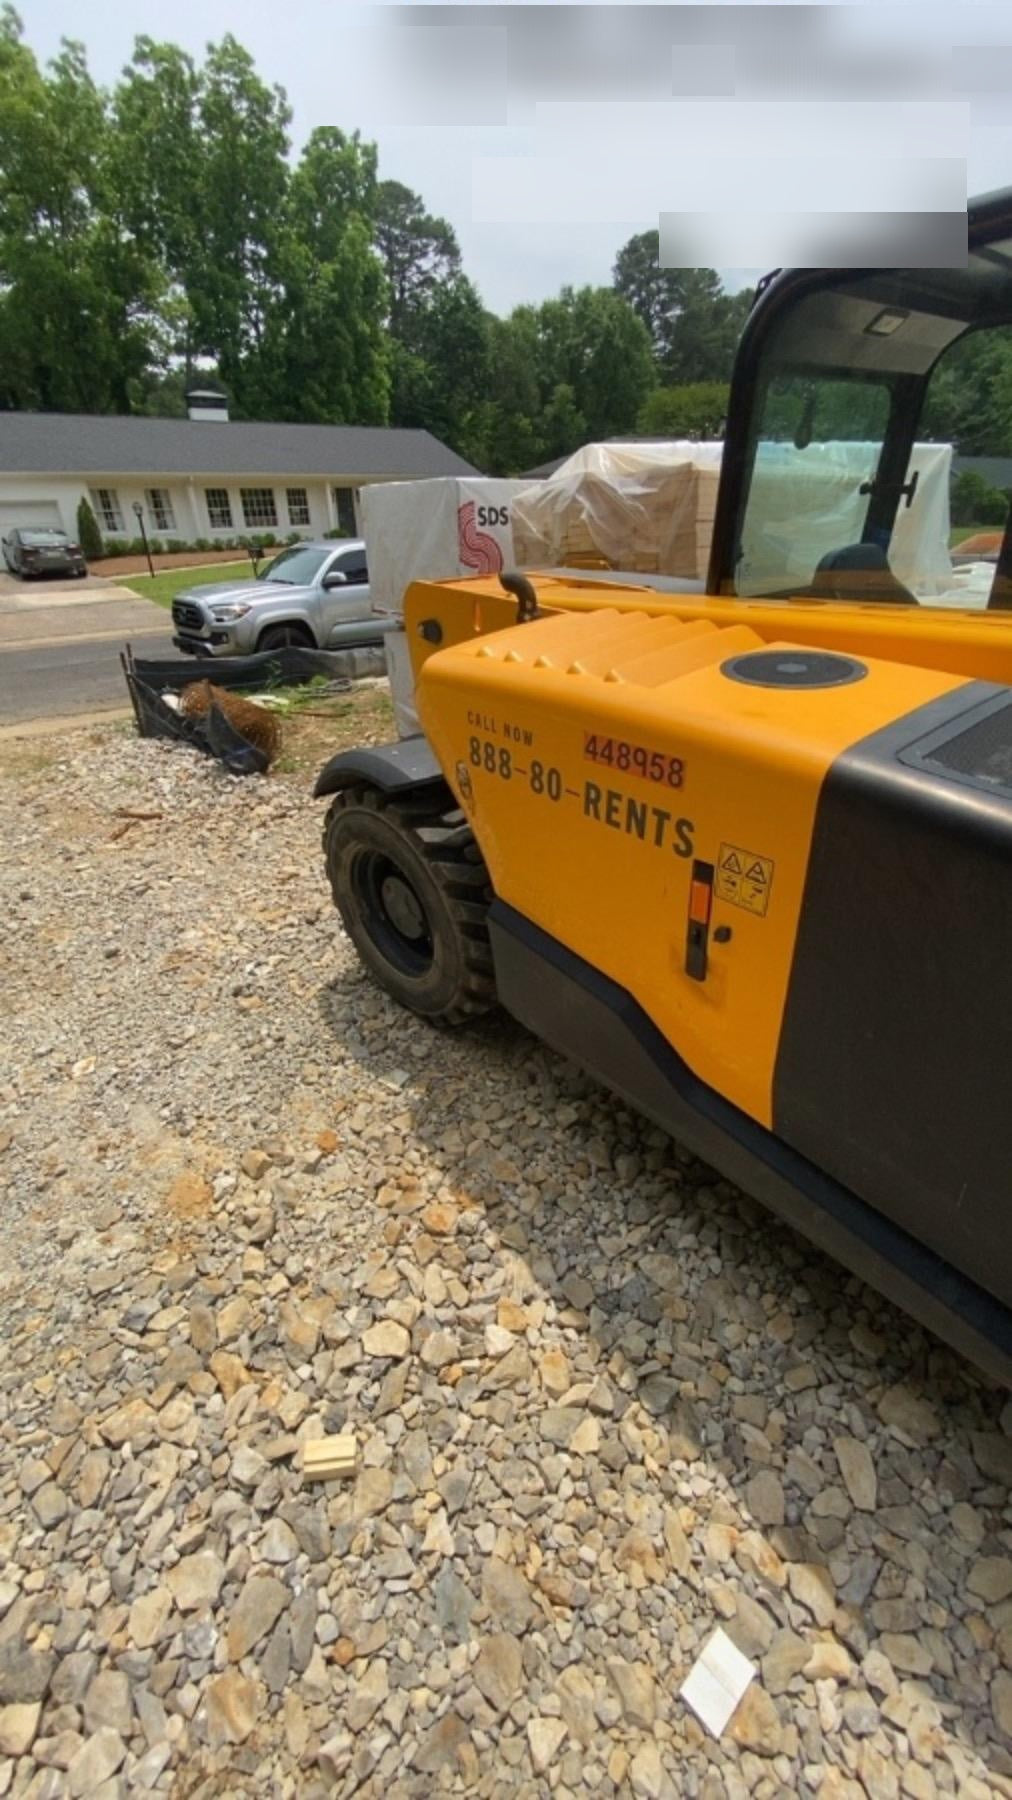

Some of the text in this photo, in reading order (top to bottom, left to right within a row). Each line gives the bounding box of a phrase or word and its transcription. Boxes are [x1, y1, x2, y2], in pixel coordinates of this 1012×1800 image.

[477, 506, 509, 526] SDS
[467, 710, 534, 747] CALL NOW
[584, 734, 685, 790] 448958
[469, 736, 695, 859] 888-80-RENTS
